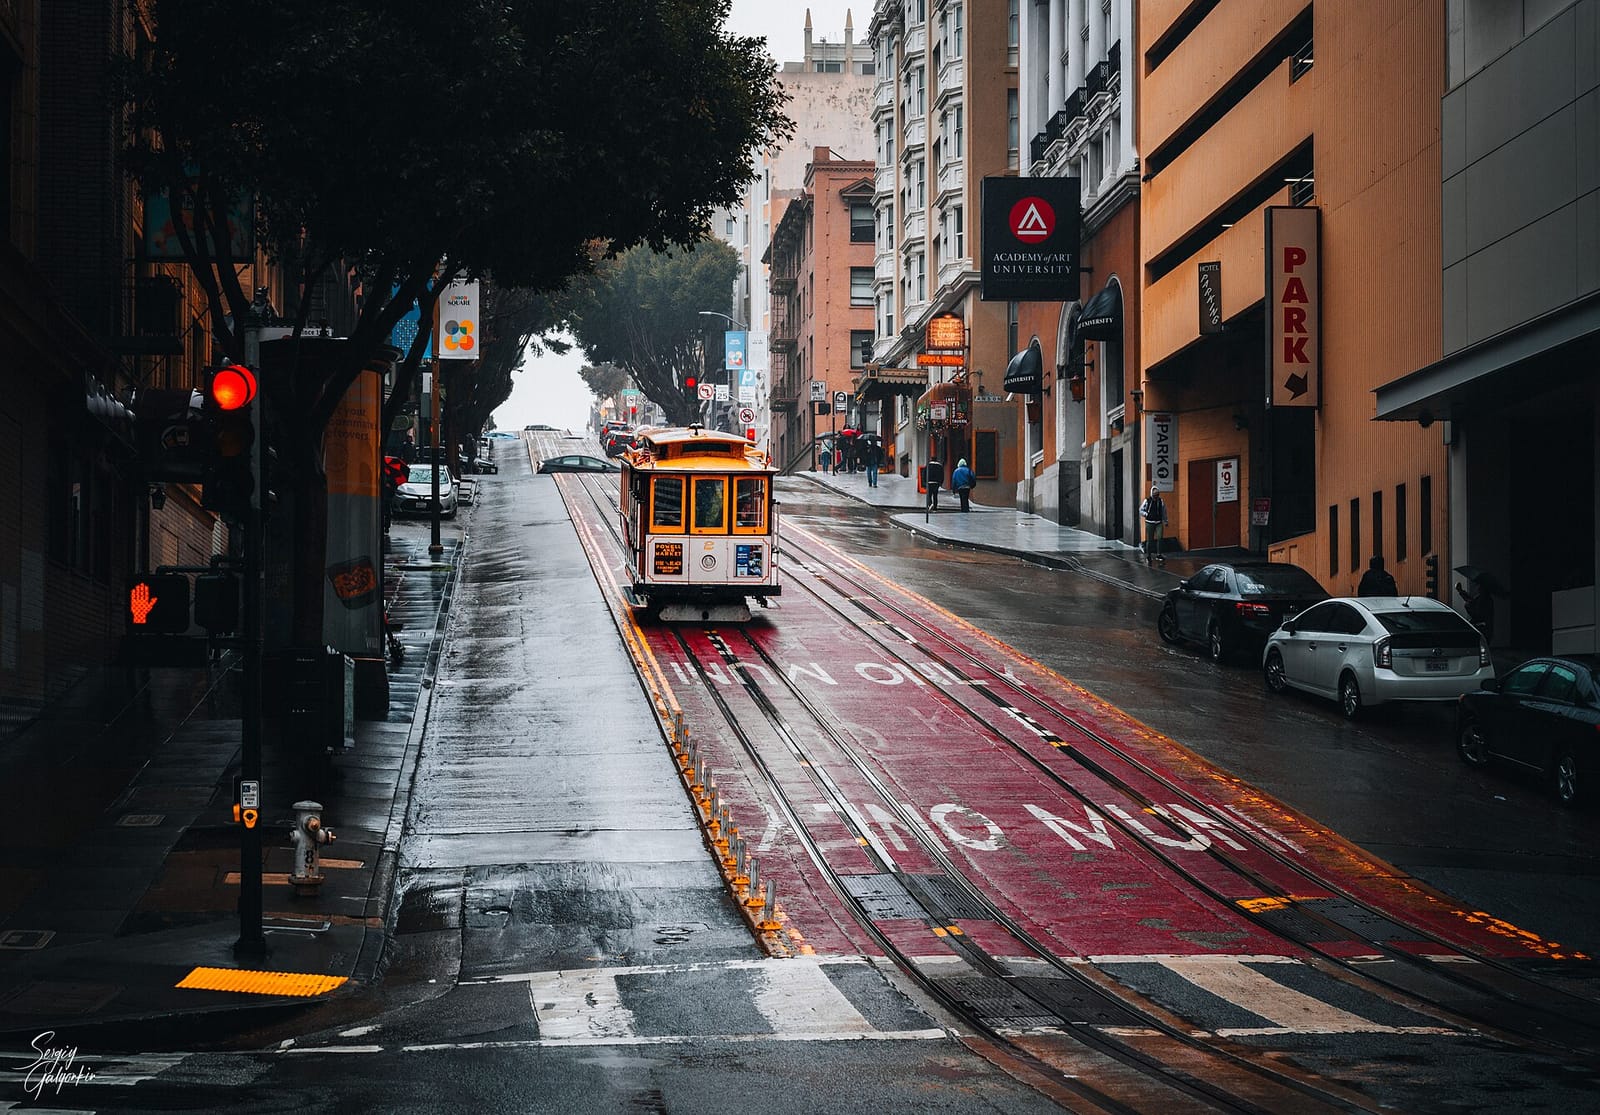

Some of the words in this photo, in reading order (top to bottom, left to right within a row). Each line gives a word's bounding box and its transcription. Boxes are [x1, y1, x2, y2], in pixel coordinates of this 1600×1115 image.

[993, 253, 1043, 262] ACADEMY
[1043, 254, 1053, 264] of
[1053, 253, 1072, 262] ART
[993, 265, 1072, 273] UNIVERSITY
[1200, 273, 1220, 325] PARKING
[1281, 247, 1311, 363] PARK
[938, 331, 955, 339] Drop
[1157, 424, 1169, 465] PARK
[306, 850, 313, 863] 8
